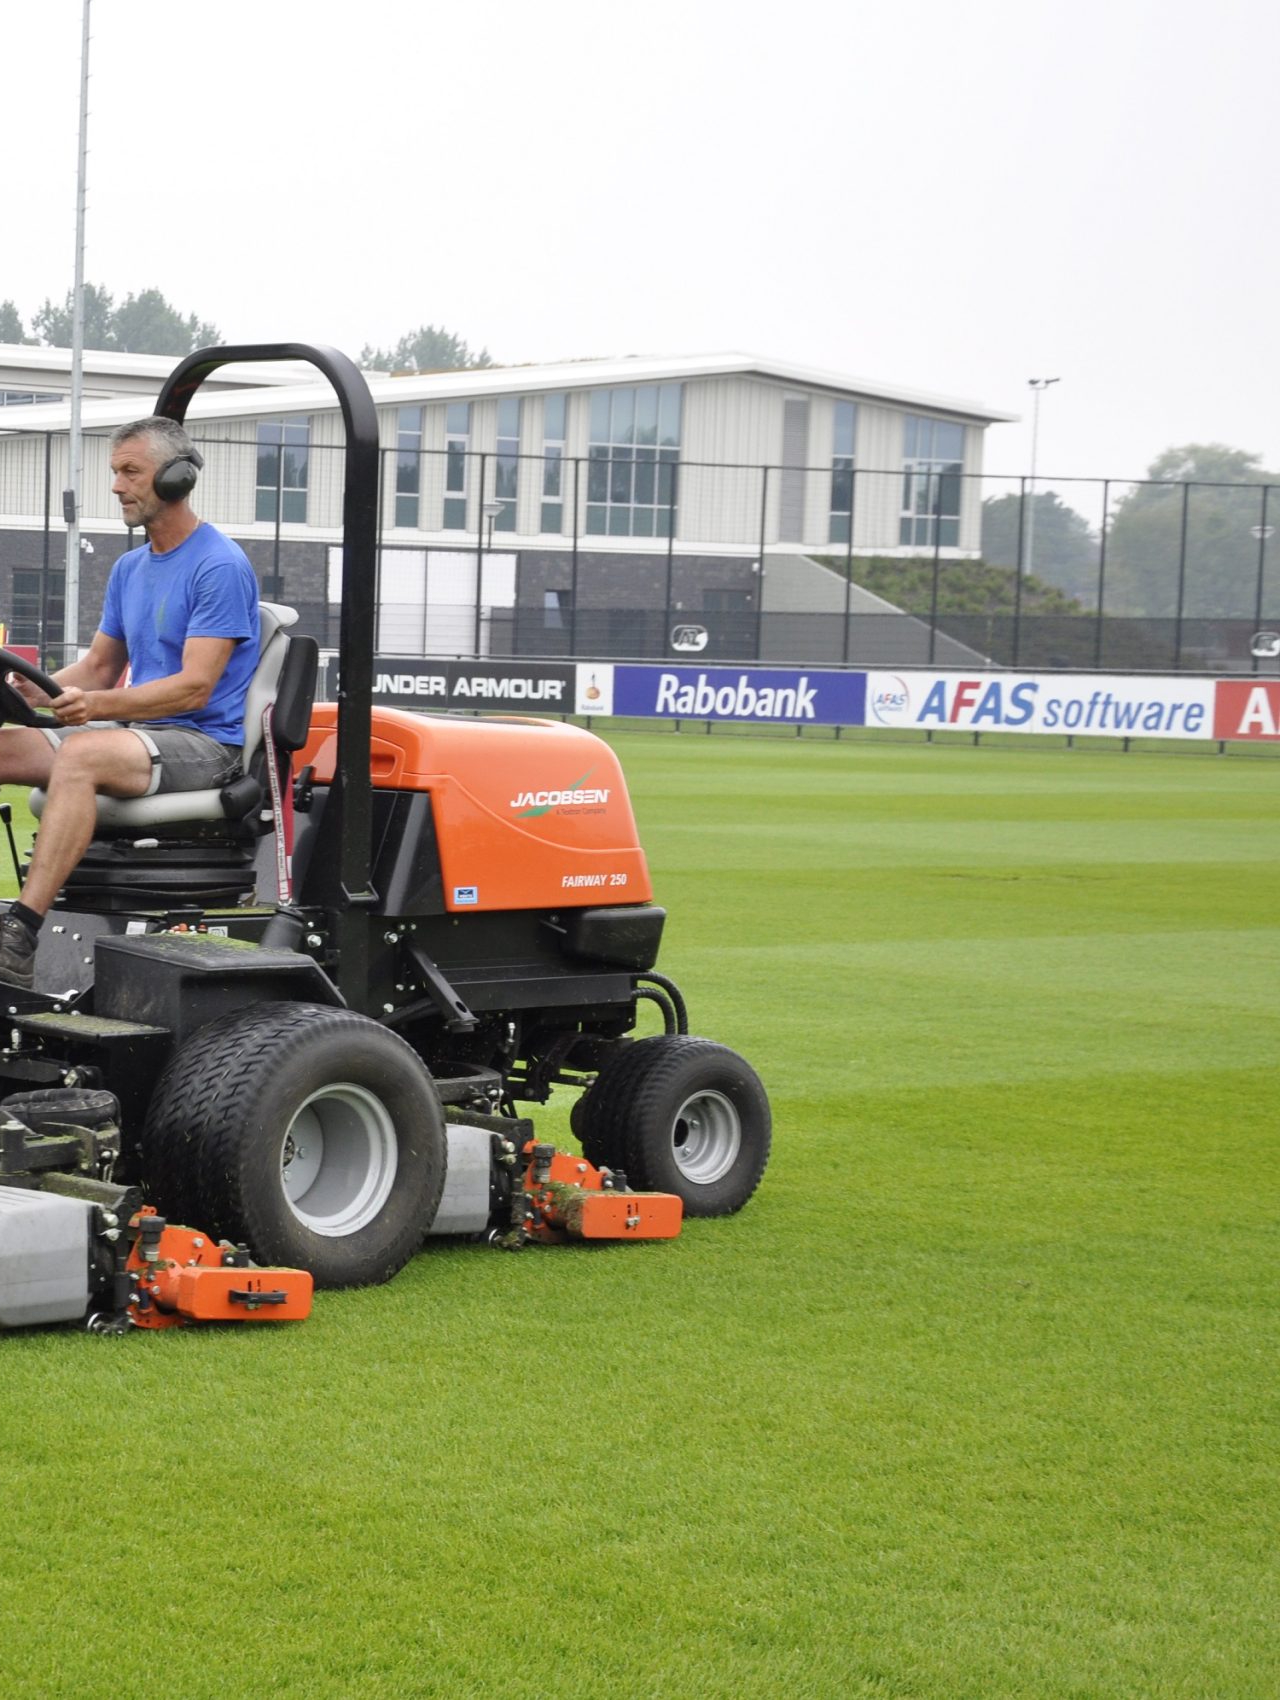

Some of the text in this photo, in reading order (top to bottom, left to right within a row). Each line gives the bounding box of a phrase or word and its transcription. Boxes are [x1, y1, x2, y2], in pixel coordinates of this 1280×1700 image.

[452, 676, 563, 700] ARMOUR
[655, 673, 818, 719] Rabobank
[916, 680, 1205, 732] AFAS software
[510, 789, 609, 808] JACOBSEN
[561, 873, 628, 888] FAIRWAY 250
